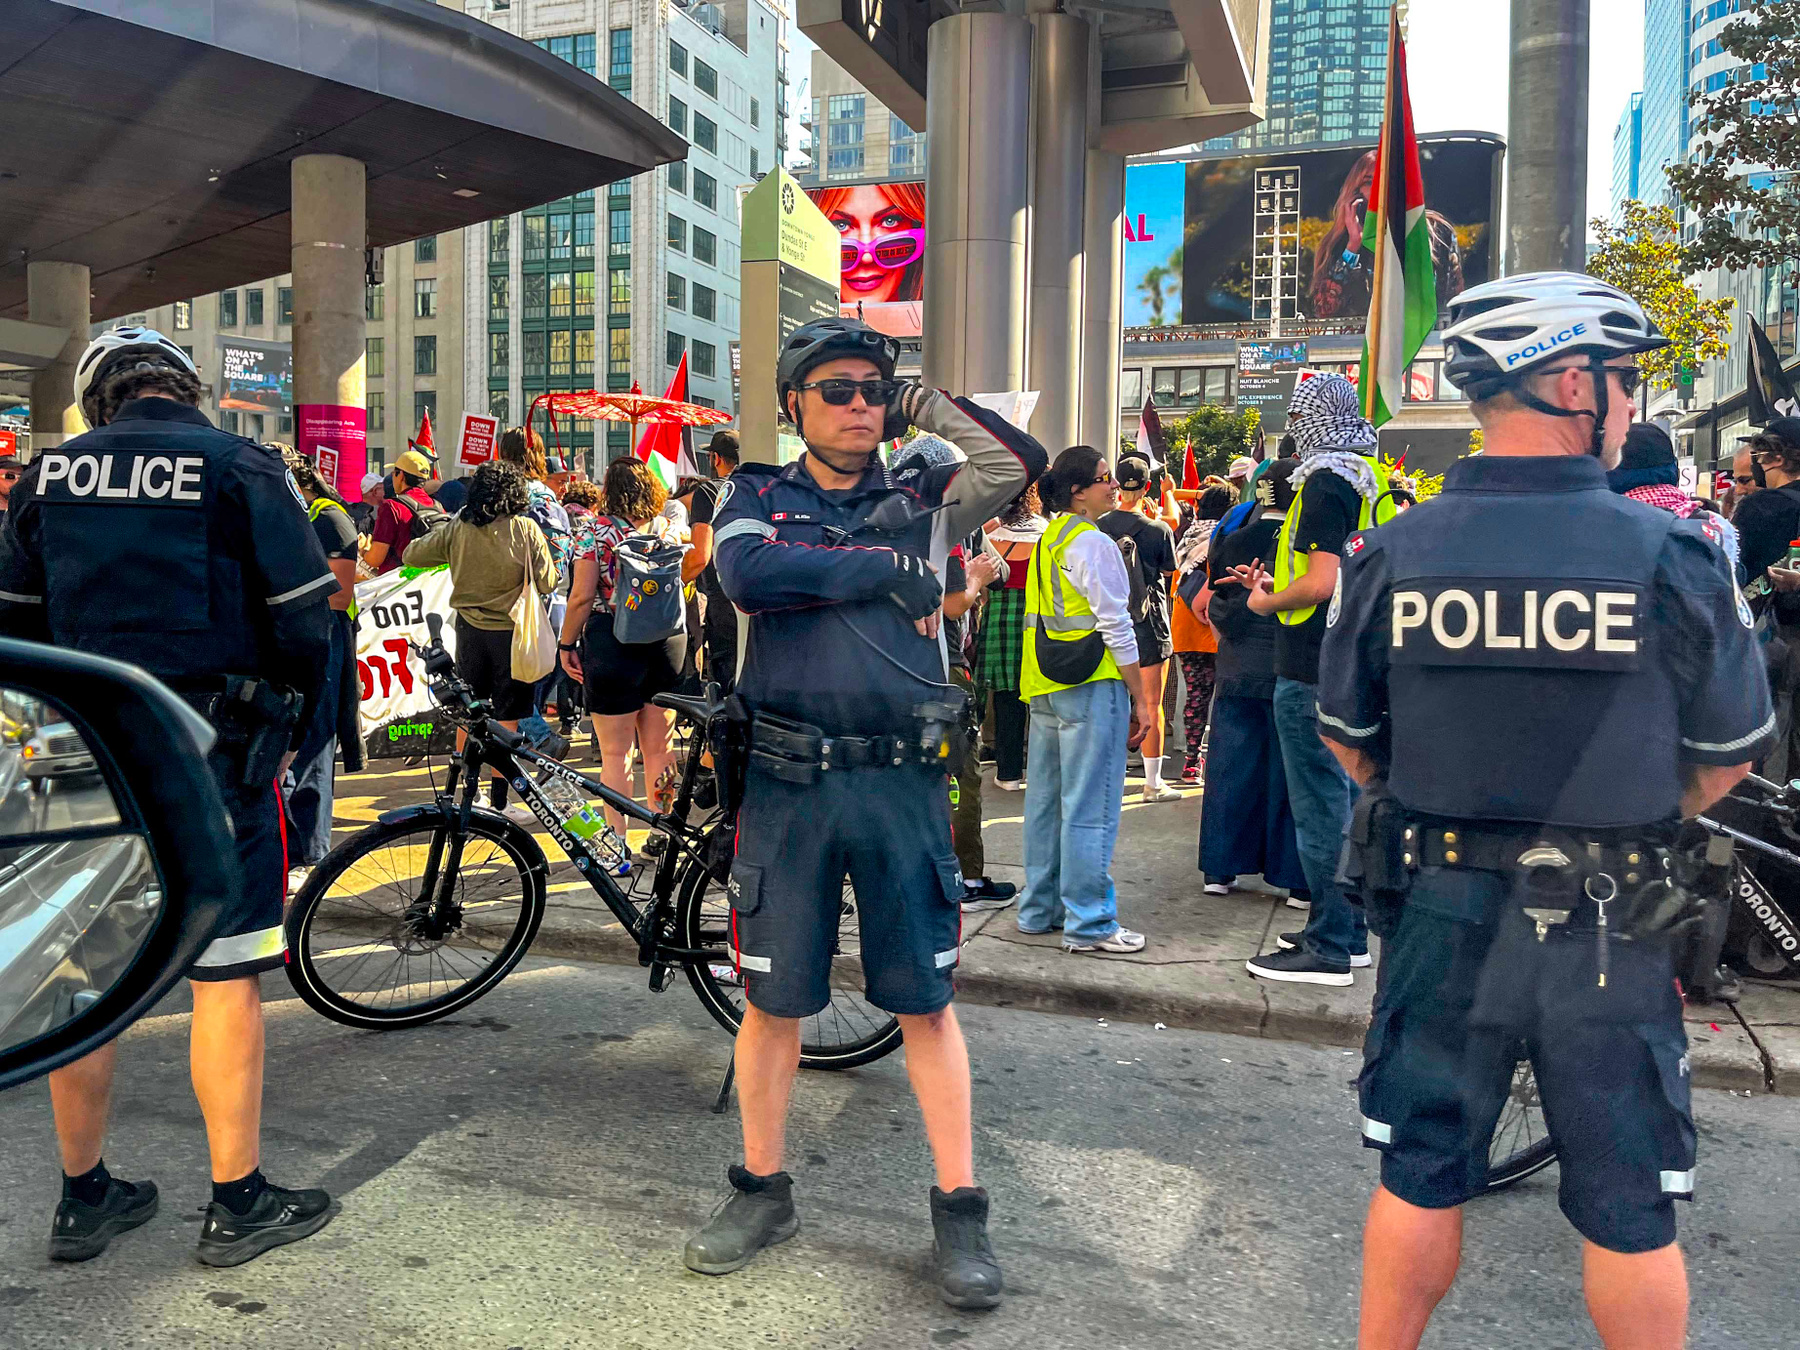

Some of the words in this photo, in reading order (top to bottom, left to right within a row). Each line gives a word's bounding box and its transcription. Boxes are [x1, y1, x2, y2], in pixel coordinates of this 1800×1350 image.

[781, 229, 798, 247] Dundas
[786, 244, 800, 261] Yonge
[1506, 322, 1587, 366] POLICE
[225, 348, 265, 360] WHAT'S
[225, 356, 240, 365] ON
[241, 358, 256, 366] AT
[225, 363, 244, 372] THE
[224, 371, 263, 381] SQUARE
[305, 418, 343, 426] Disappearing
[471, 421, 490, 430] DOWN
[36, 455, 203, 500] POLICE
[1392, 589, 1637, 652] POLICE
[525, 791, 574, 851] TORONTO
